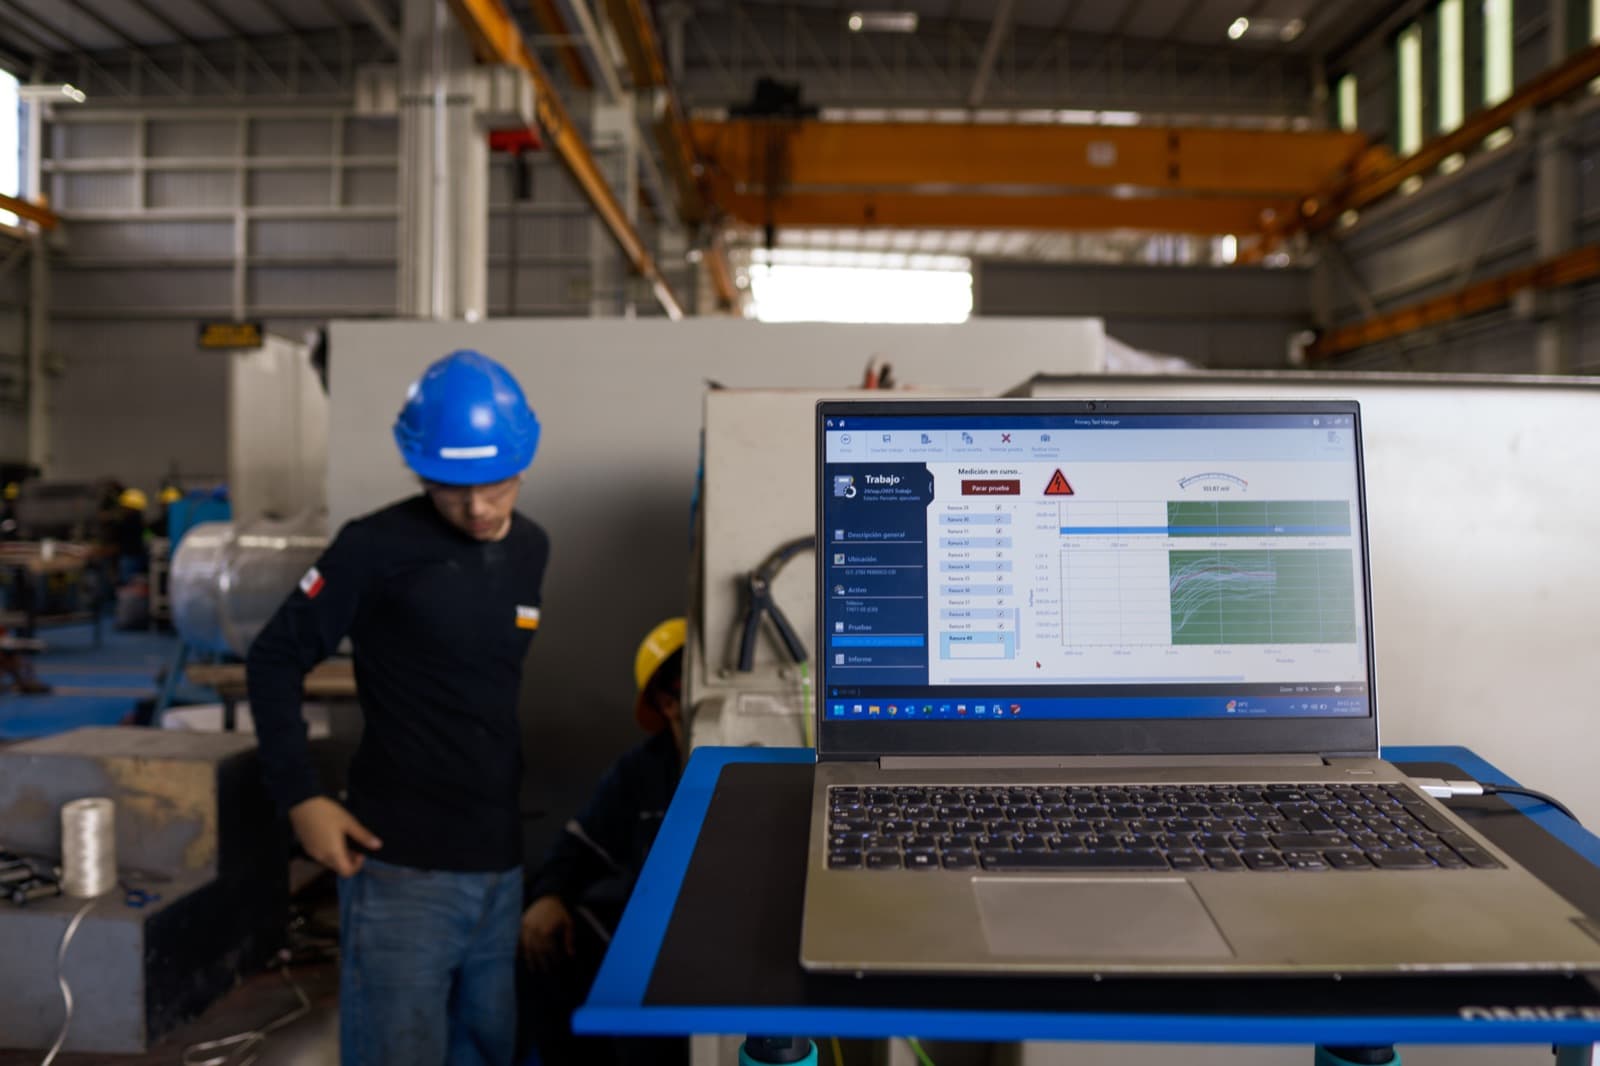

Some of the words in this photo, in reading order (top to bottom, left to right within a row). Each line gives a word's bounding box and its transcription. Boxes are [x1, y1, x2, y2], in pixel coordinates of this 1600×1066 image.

[864, 474, 900, 486] Trabajo
[972, 484, 987, 492] Parar
[988, 484, 1010, 493] prueba
[848, 531, 882, 539] Descripción
[883, 531, 905, 540] general
